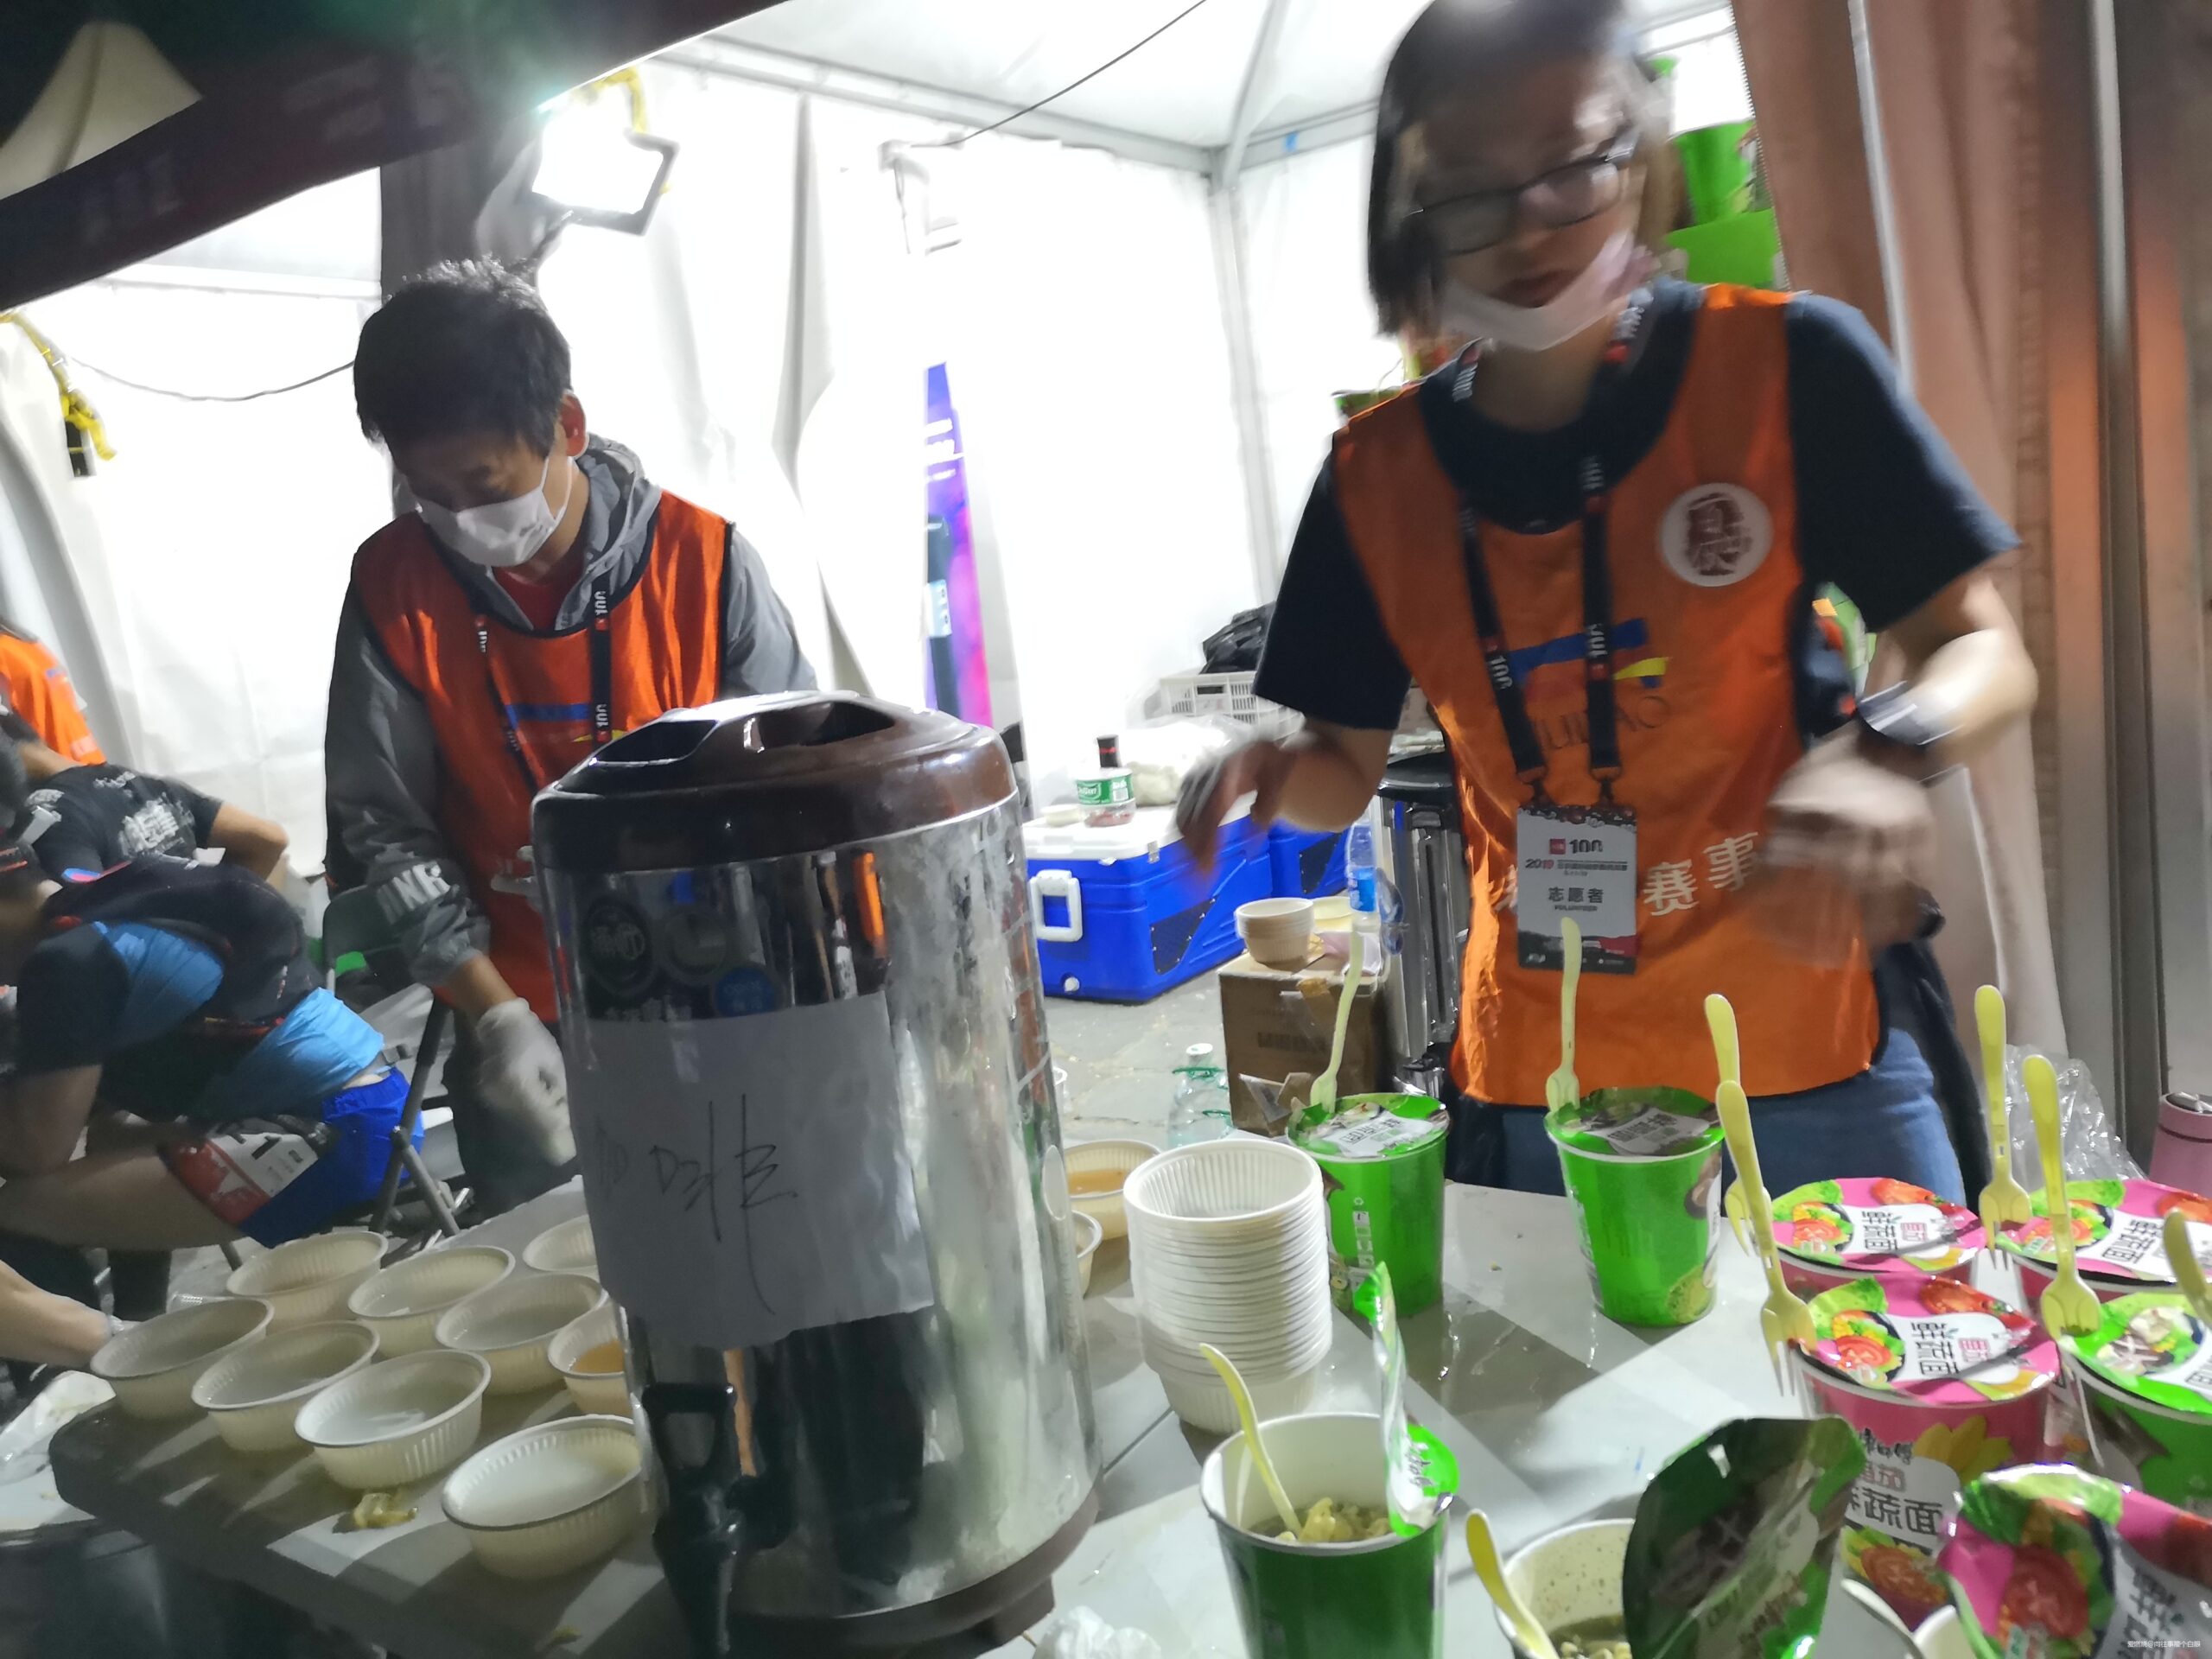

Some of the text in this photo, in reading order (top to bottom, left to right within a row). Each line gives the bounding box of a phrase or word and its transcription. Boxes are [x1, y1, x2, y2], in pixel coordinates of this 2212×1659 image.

[1487, 654, 1514, 690] 100
[1568, 839, 1604, 854] 100
[1548, 887, 1605, 904] 志愿者
